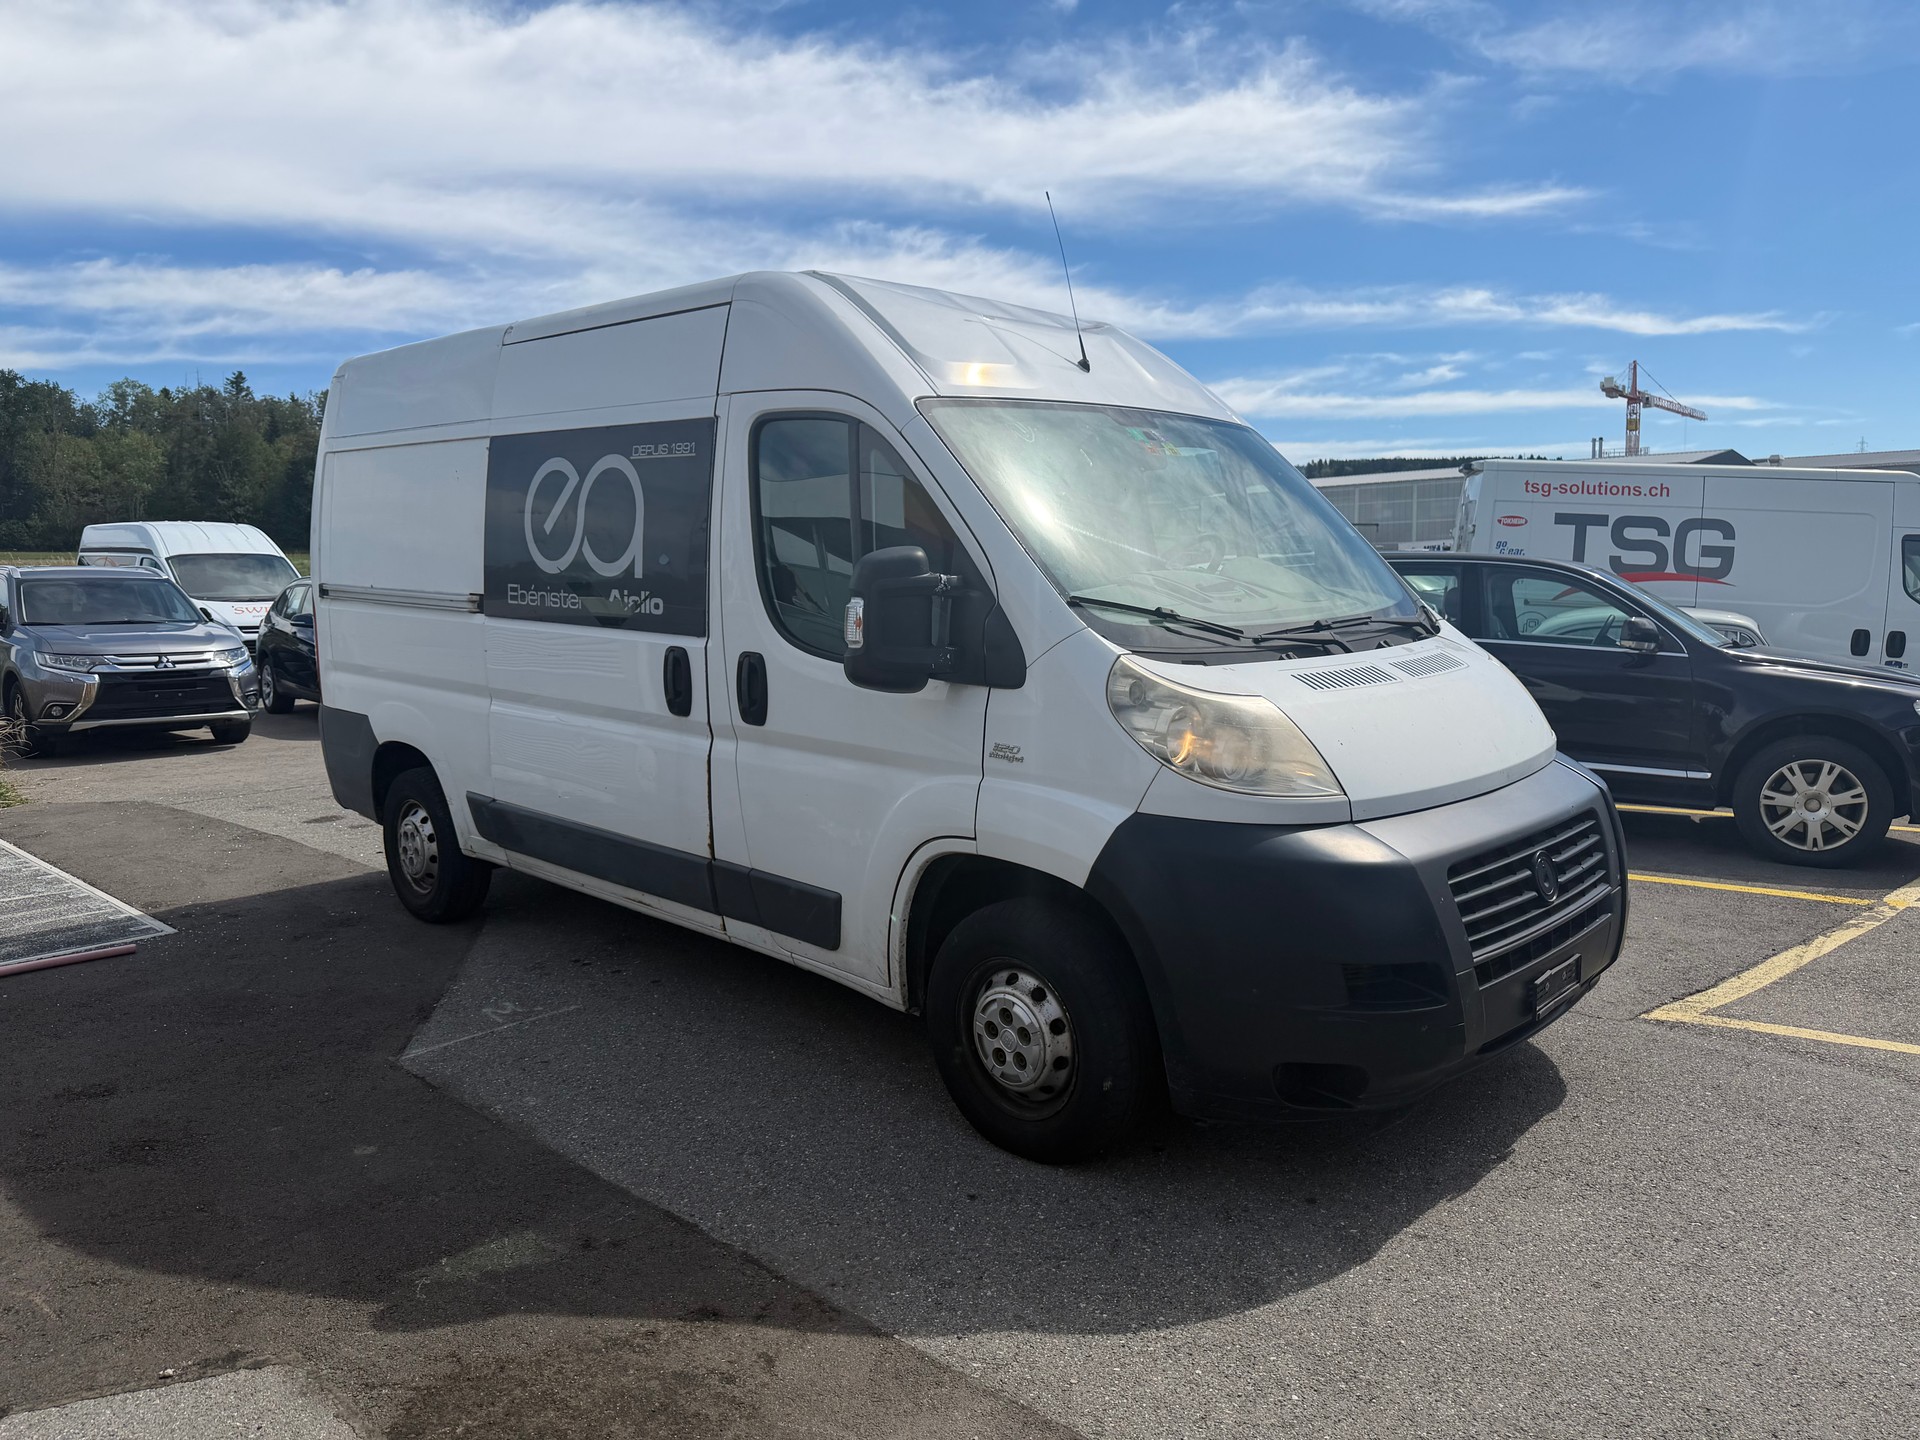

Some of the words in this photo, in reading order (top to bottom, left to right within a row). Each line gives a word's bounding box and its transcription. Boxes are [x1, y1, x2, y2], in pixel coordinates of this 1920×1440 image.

[632, 443, 669, 457] DEPUIS
[671, 441, 696, 455] 1991
[1524, 479, 1671, 498] tsg-solutions.ch
[1554, 511, 1737, 581] TSG
